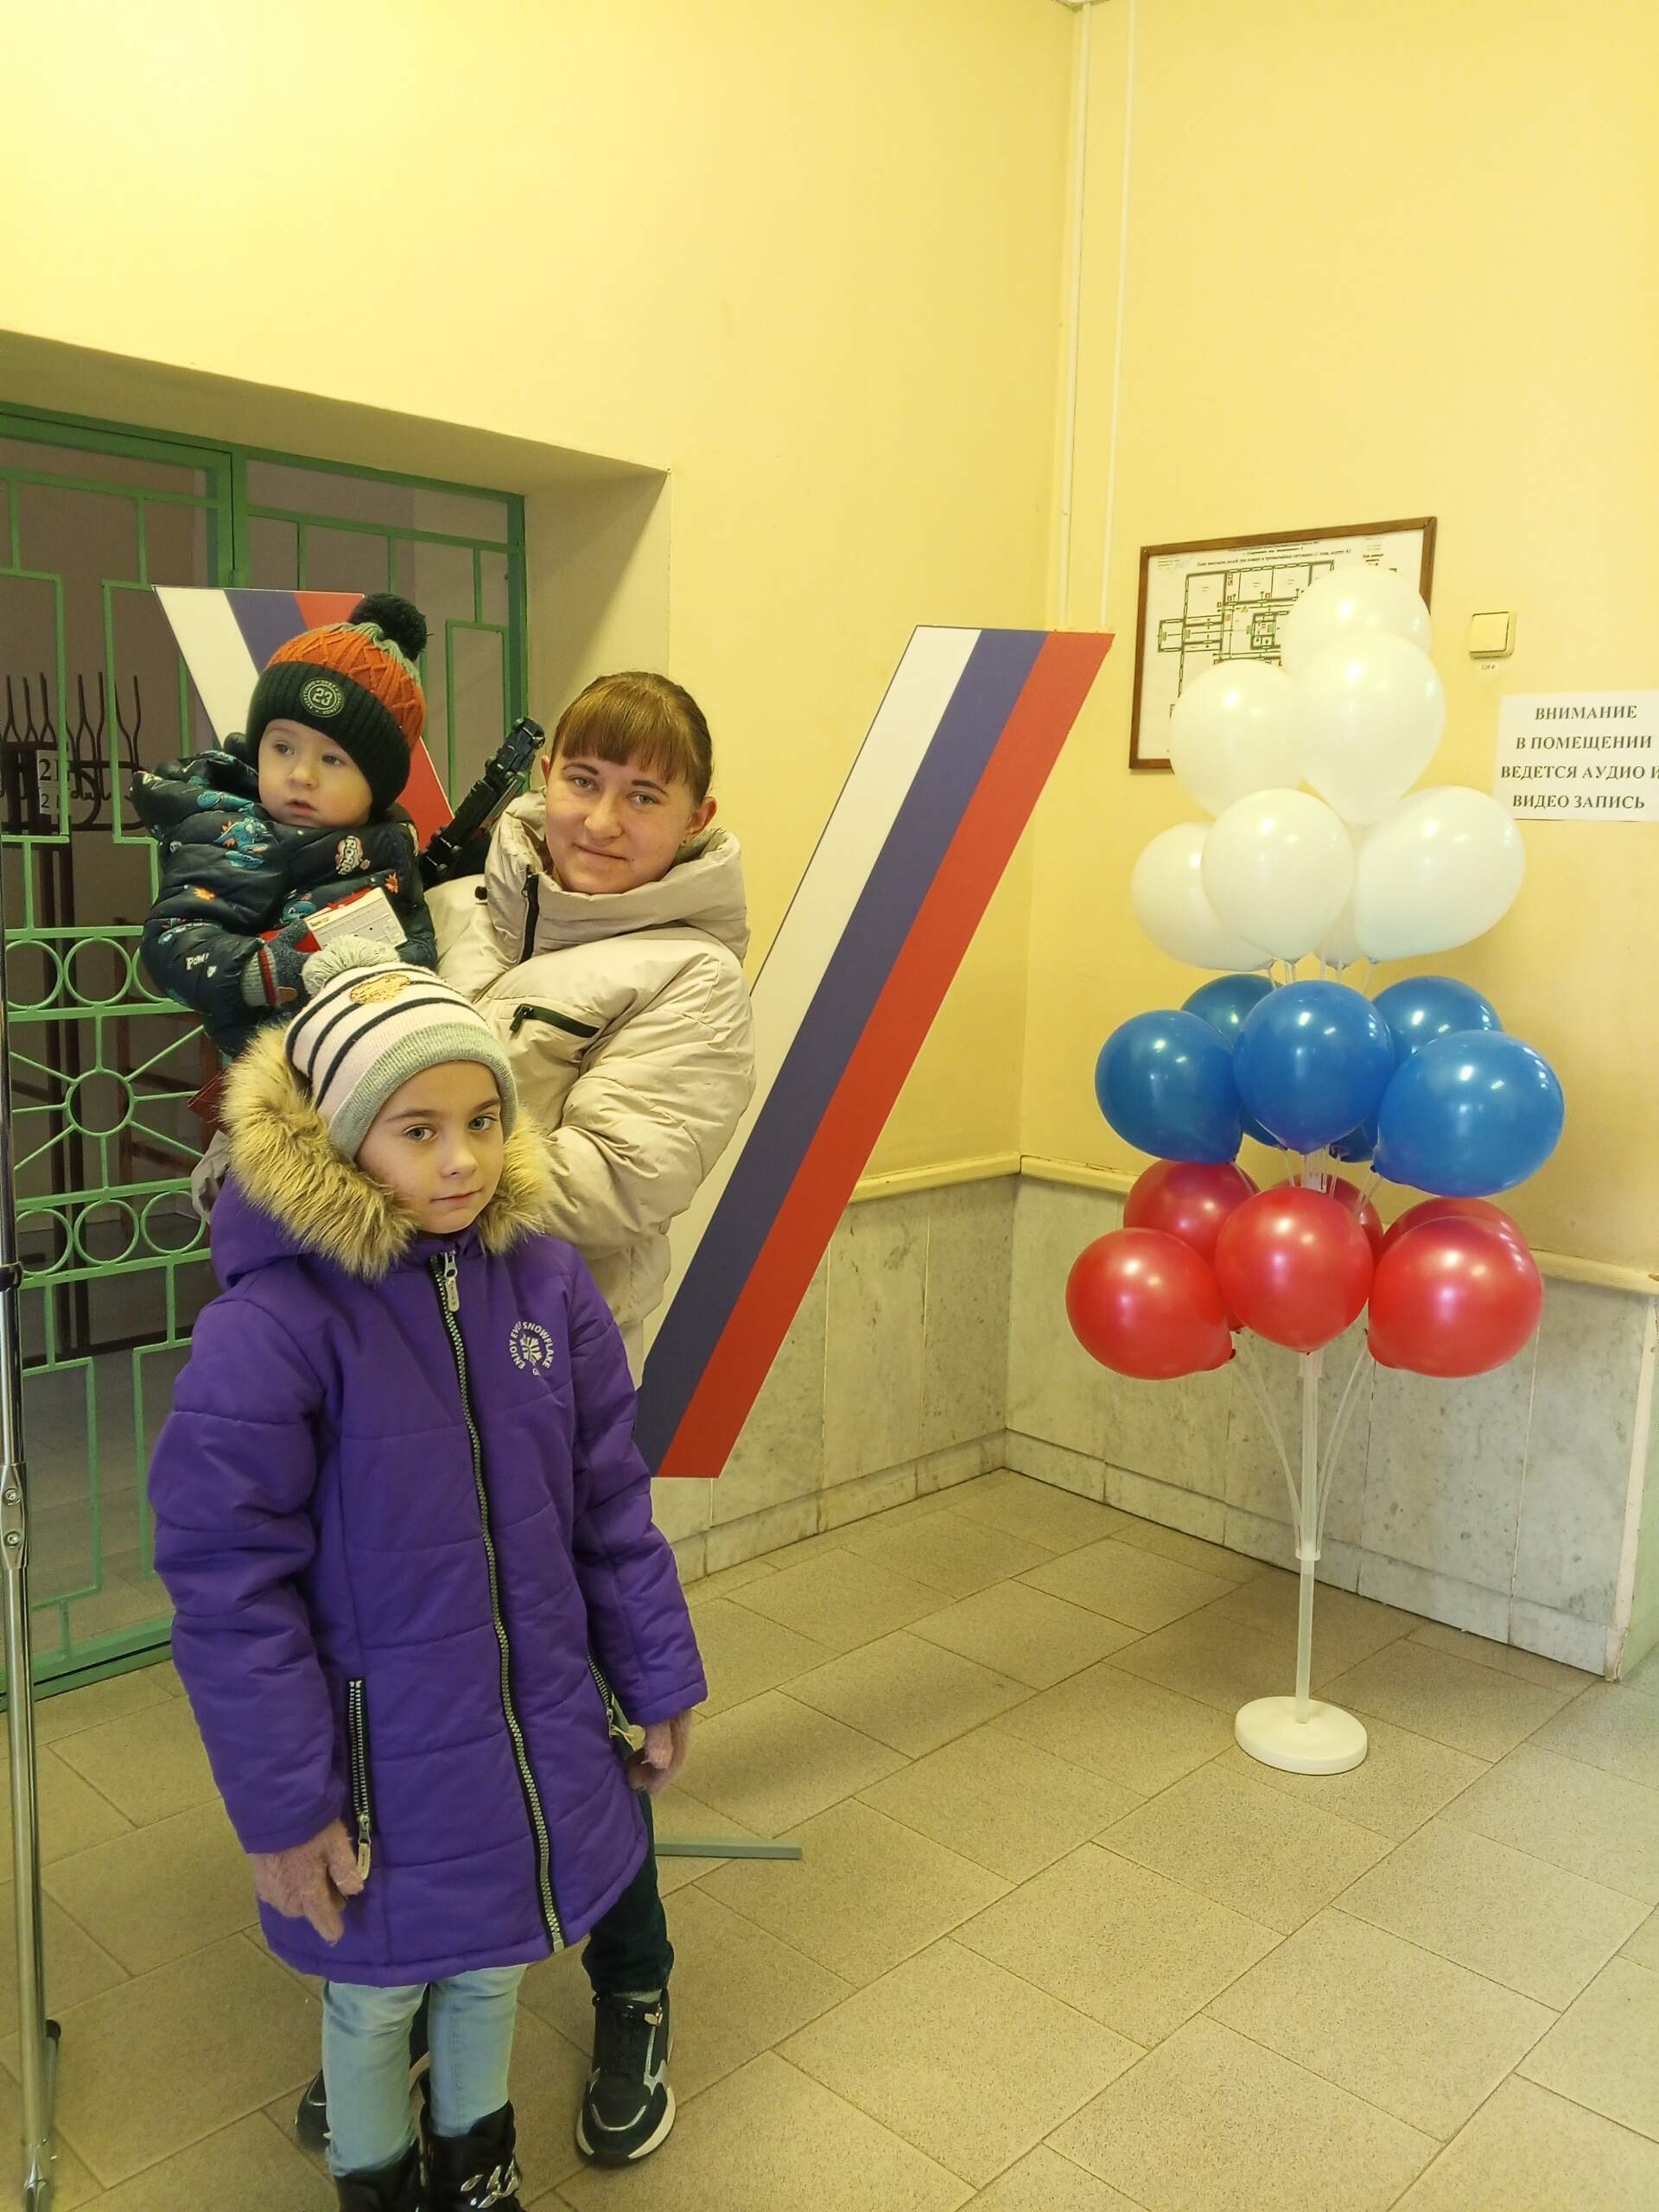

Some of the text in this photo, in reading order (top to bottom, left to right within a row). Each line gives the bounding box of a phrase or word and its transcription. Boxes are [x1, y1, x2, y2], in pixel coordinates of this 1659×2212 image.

[312, 687, 334, 706] 23
[1535, 705, 1637, 721] ВНИМАНИЕ
[1516, 735, 1652, 752] В ПОМЕЩЕНИИ
[1500, 766, 1578, 781] ВЕДЕТСЯ
[1581, 766, 1646, 781] АУДИО
[1512, 794, 1645, 810] ВИДЕО ЗАПИСЬ
[509, 1339, 525, 1370] ENJOY
[522, 1321, 554, 1370] SNOWFLAKE
